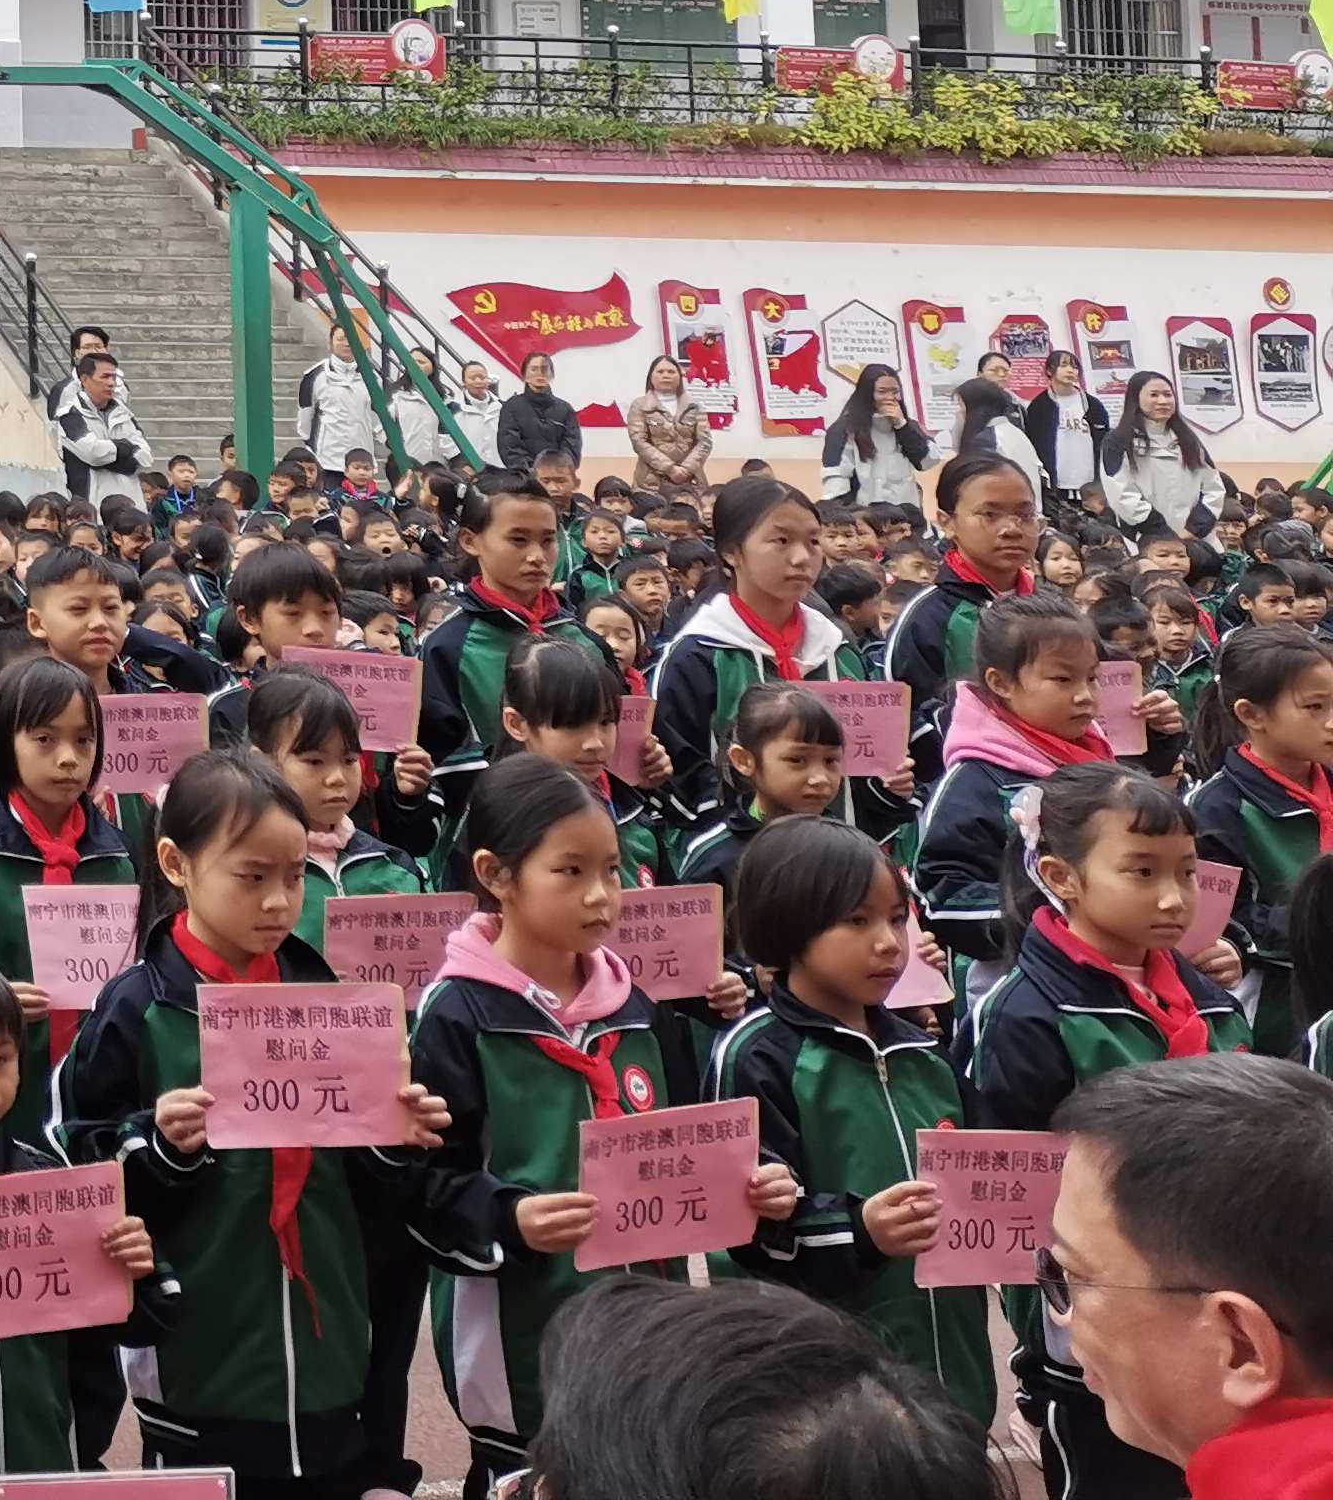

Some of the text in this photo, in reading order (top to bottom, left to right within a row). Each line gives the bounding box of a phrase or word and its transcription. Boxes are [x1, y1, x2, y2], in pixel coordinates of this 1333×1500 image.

[764, 302, 782, 320] 大
[117, 726, 160, 741] 慰问金
[853, 734, 875, 758] 元
[104, 749, 170, 774] 300 元
[79, 926, 130, 944] 慰问金
[374, 933, 421, 950] 慰问金
[619, 924, 666, 943] 慰问金
[65, 957, 109, 982] 300
[403, 960, 430, 988] 元
[622, 950, 679, 980] 0 元
[202, 1005, 394, 1029] 南宁市港澳同胞联谊
[265, 1037, 331, 1062] 慰问金
[242, 1077, 349, 1115] 300 元
[585, 1118, 752, 1161] 南宁市港澳同胞联谊
[636, 1153, 696, 1180] 慰问金
[971, 1180, 1027, 1201] 慰问金
[616, 1187, 708, 1233] 300 元
[949, 1216, 1035, 1253] 300 元
[35, 1258, 71, 1299] 元
